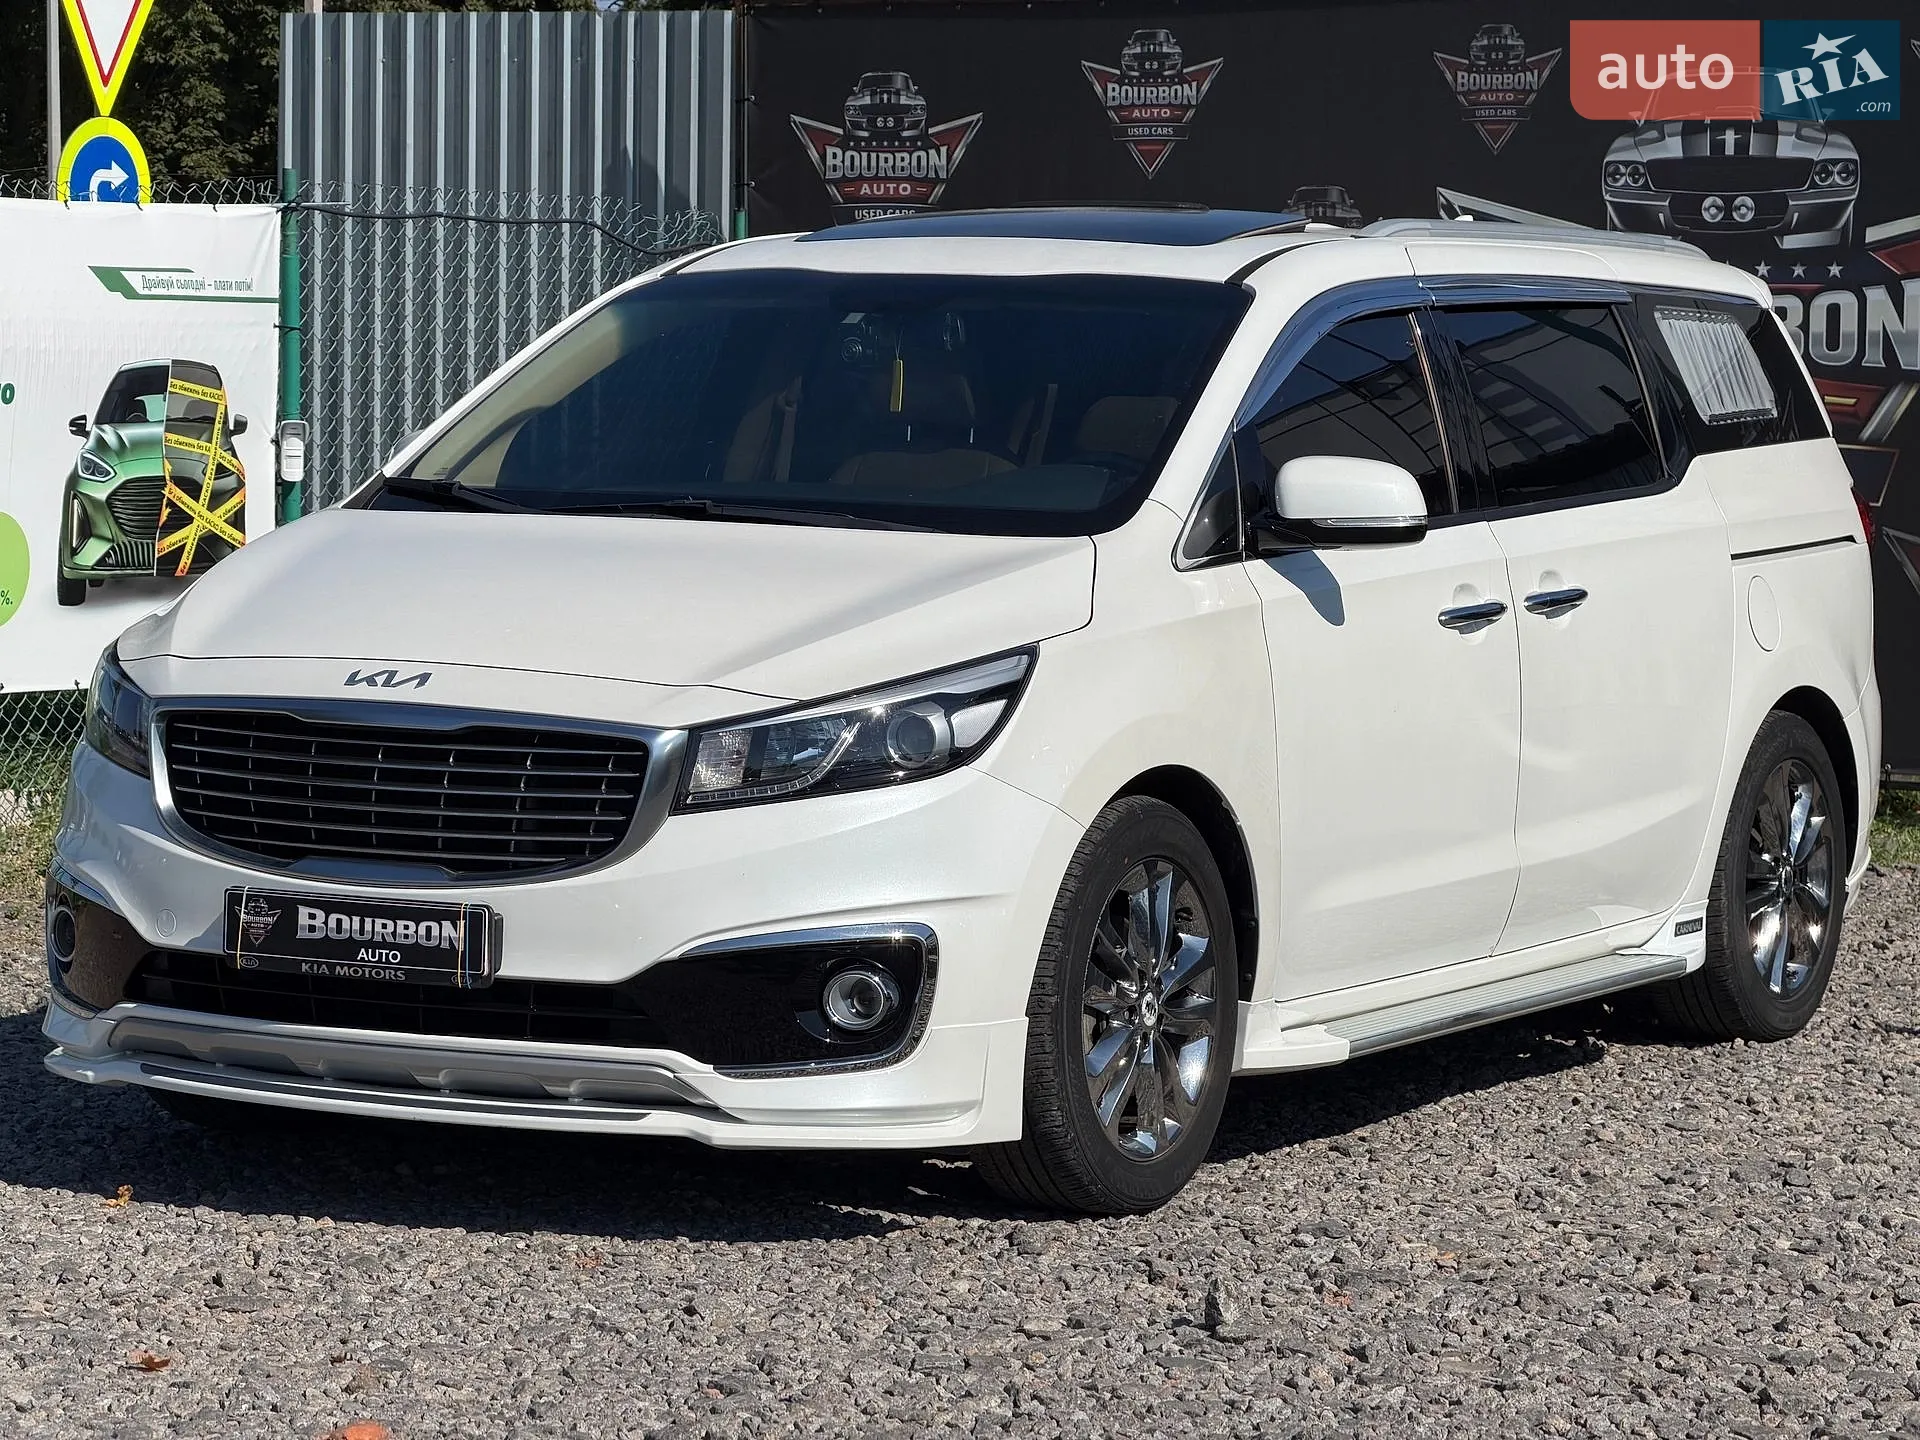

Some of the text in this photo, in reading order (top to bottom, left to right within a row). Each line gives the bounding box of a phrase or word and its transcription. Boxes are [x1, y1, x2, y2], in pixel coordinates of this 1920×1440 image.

[1456, 69, 1539, 92] BOURBON
[1106, 80, 1198, 106] BOURBON
[1480, 92, 1514, 101] AUTO
[1132, 108, 1171, 118] AUTO
[1475, 109, 1517, 117] USED CARS
[1128, 127, 1174, 136] USED CARS
[825, 145, 948, 179] BOURBON
[860, 183, 912, 196] AUTO
[343, 669, 433, 689] KIA
[296, 905, 466, 951] BOURBON
[357, 948, 401, 963] AUTO
[301, 962, 406, 981] KIA MOTORS
